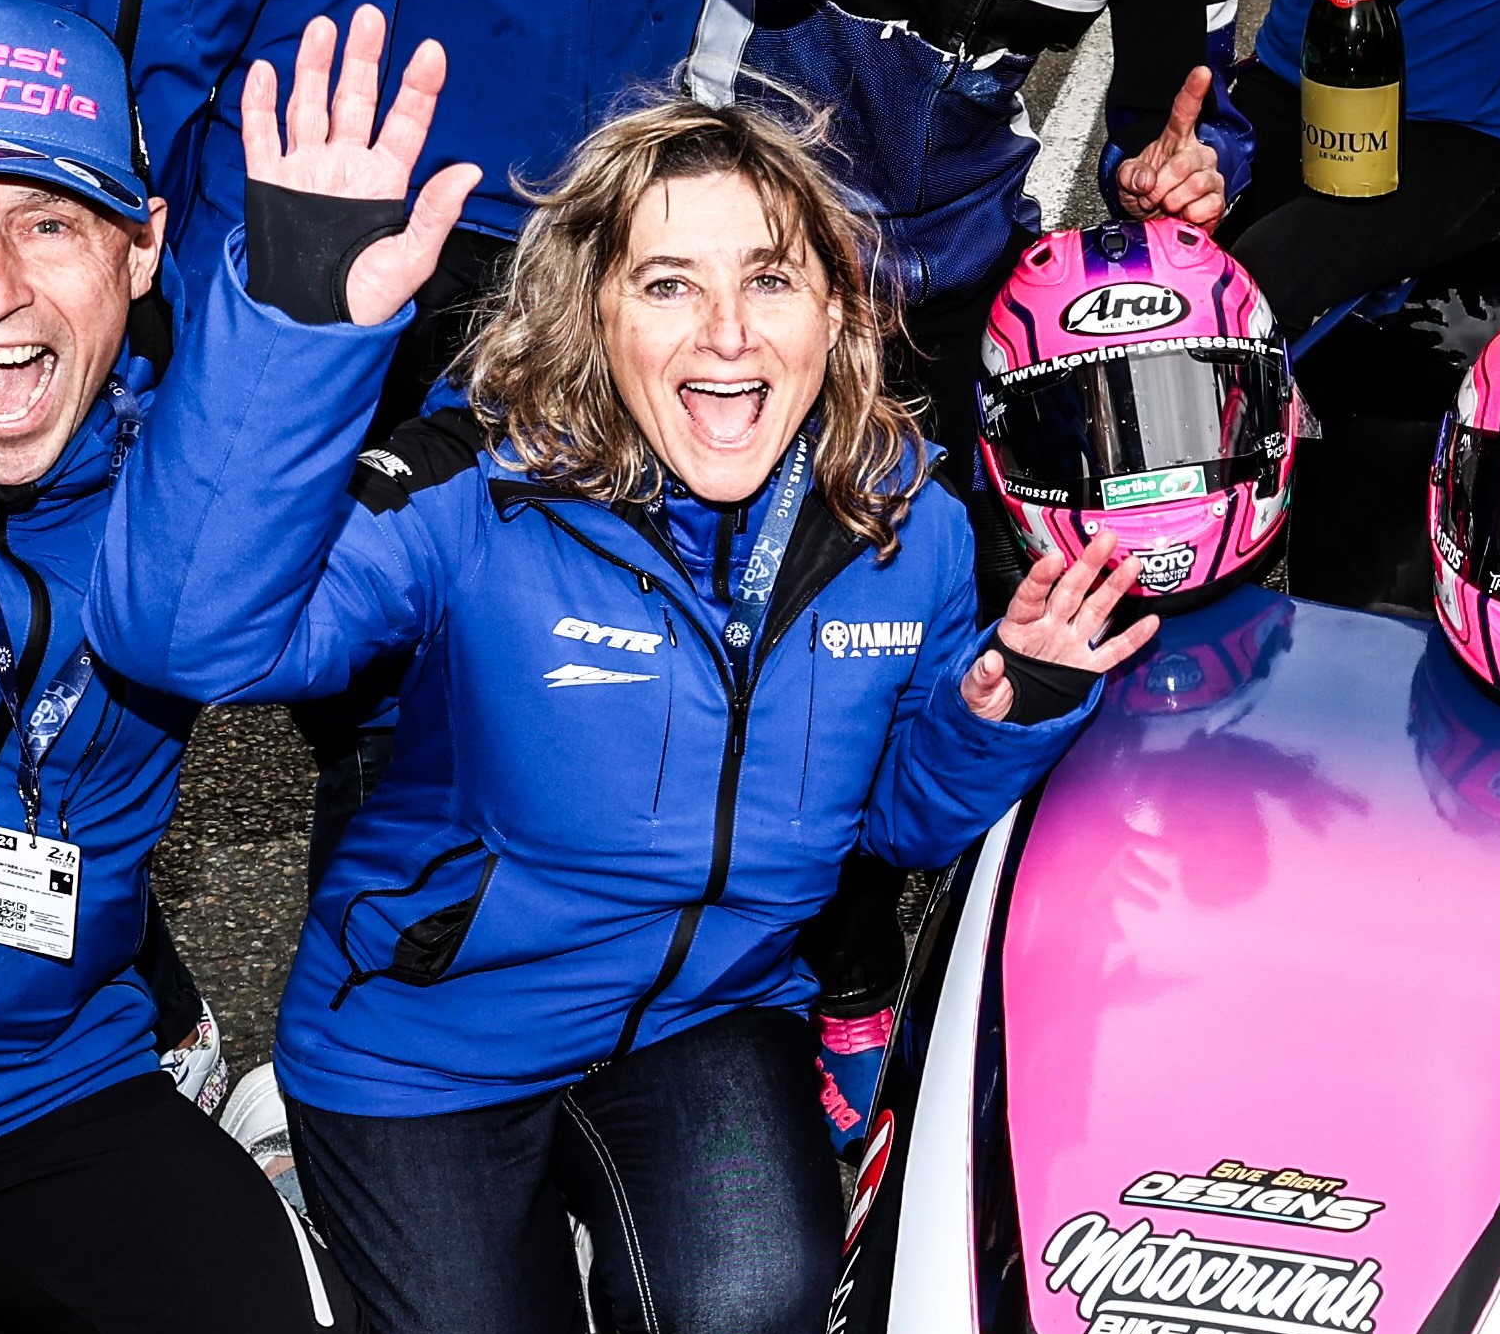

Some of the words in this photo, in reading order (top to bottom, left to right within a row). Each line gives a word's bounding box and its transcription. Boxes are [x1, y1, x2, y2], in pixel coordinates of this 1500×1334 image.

[1318, 151, 1328, 159] LE
[1331, 153, 1355, 162] MANS
[1067, 288, 1177, 330] Arai
[1001, 335, 1268, 385] www.kevin-rousseau.fr
[776, 434, 808, 519] MANS.ORG
[1107, 477, 1156, 497] Sarthe
[553, 617, 663, 653] GYTR
[849, 621, 922, 647] YAMAHA
[1125, 1173, 1383, 1230] DESIGNS
